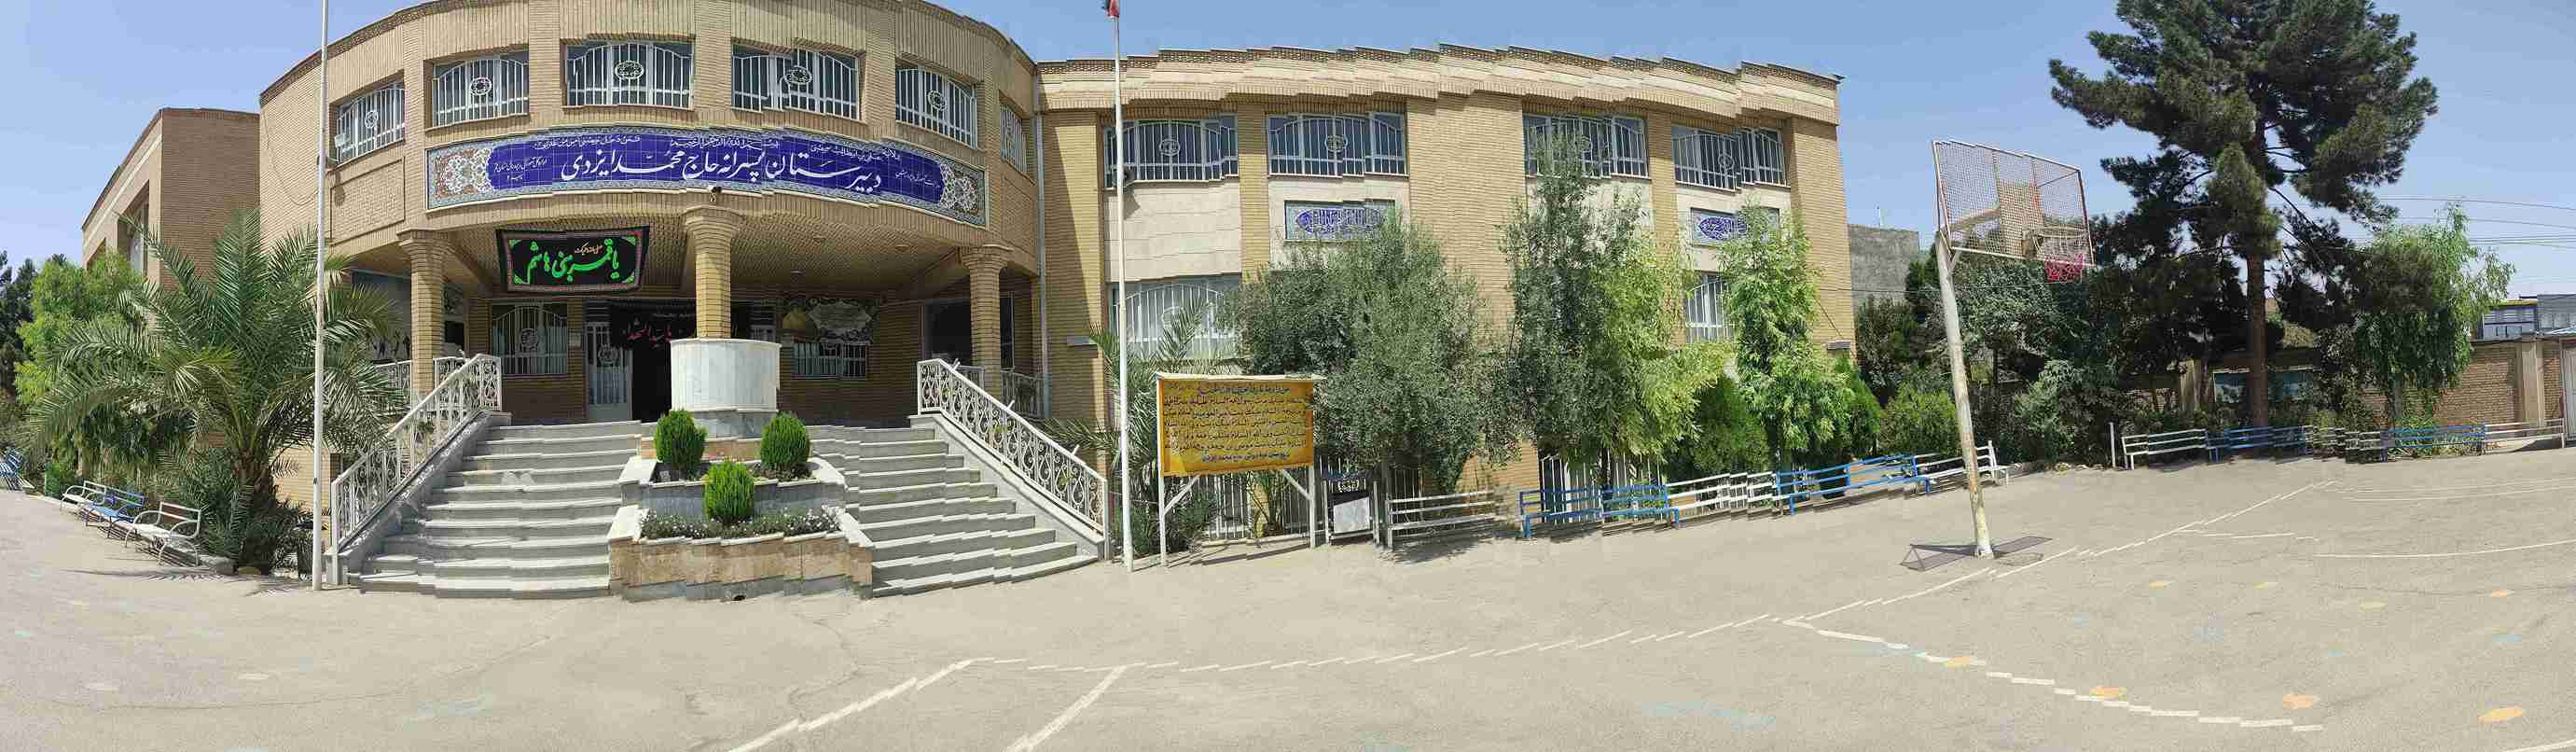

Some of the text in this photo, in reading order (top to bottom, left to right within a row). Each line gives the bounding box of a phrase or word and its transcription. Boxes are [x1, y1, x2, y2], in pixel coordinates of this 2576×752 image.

[561, 148, 616, 181] ایزدی
[612, 149, 686, 174] محمد
[682, 150, 720, 180] حاج
[716, 149, 766, 183] پسرانه
[765, 149, 882, 194] دبیرستان
[526, 238, 620, 285] یا قمر بنی هاشم
